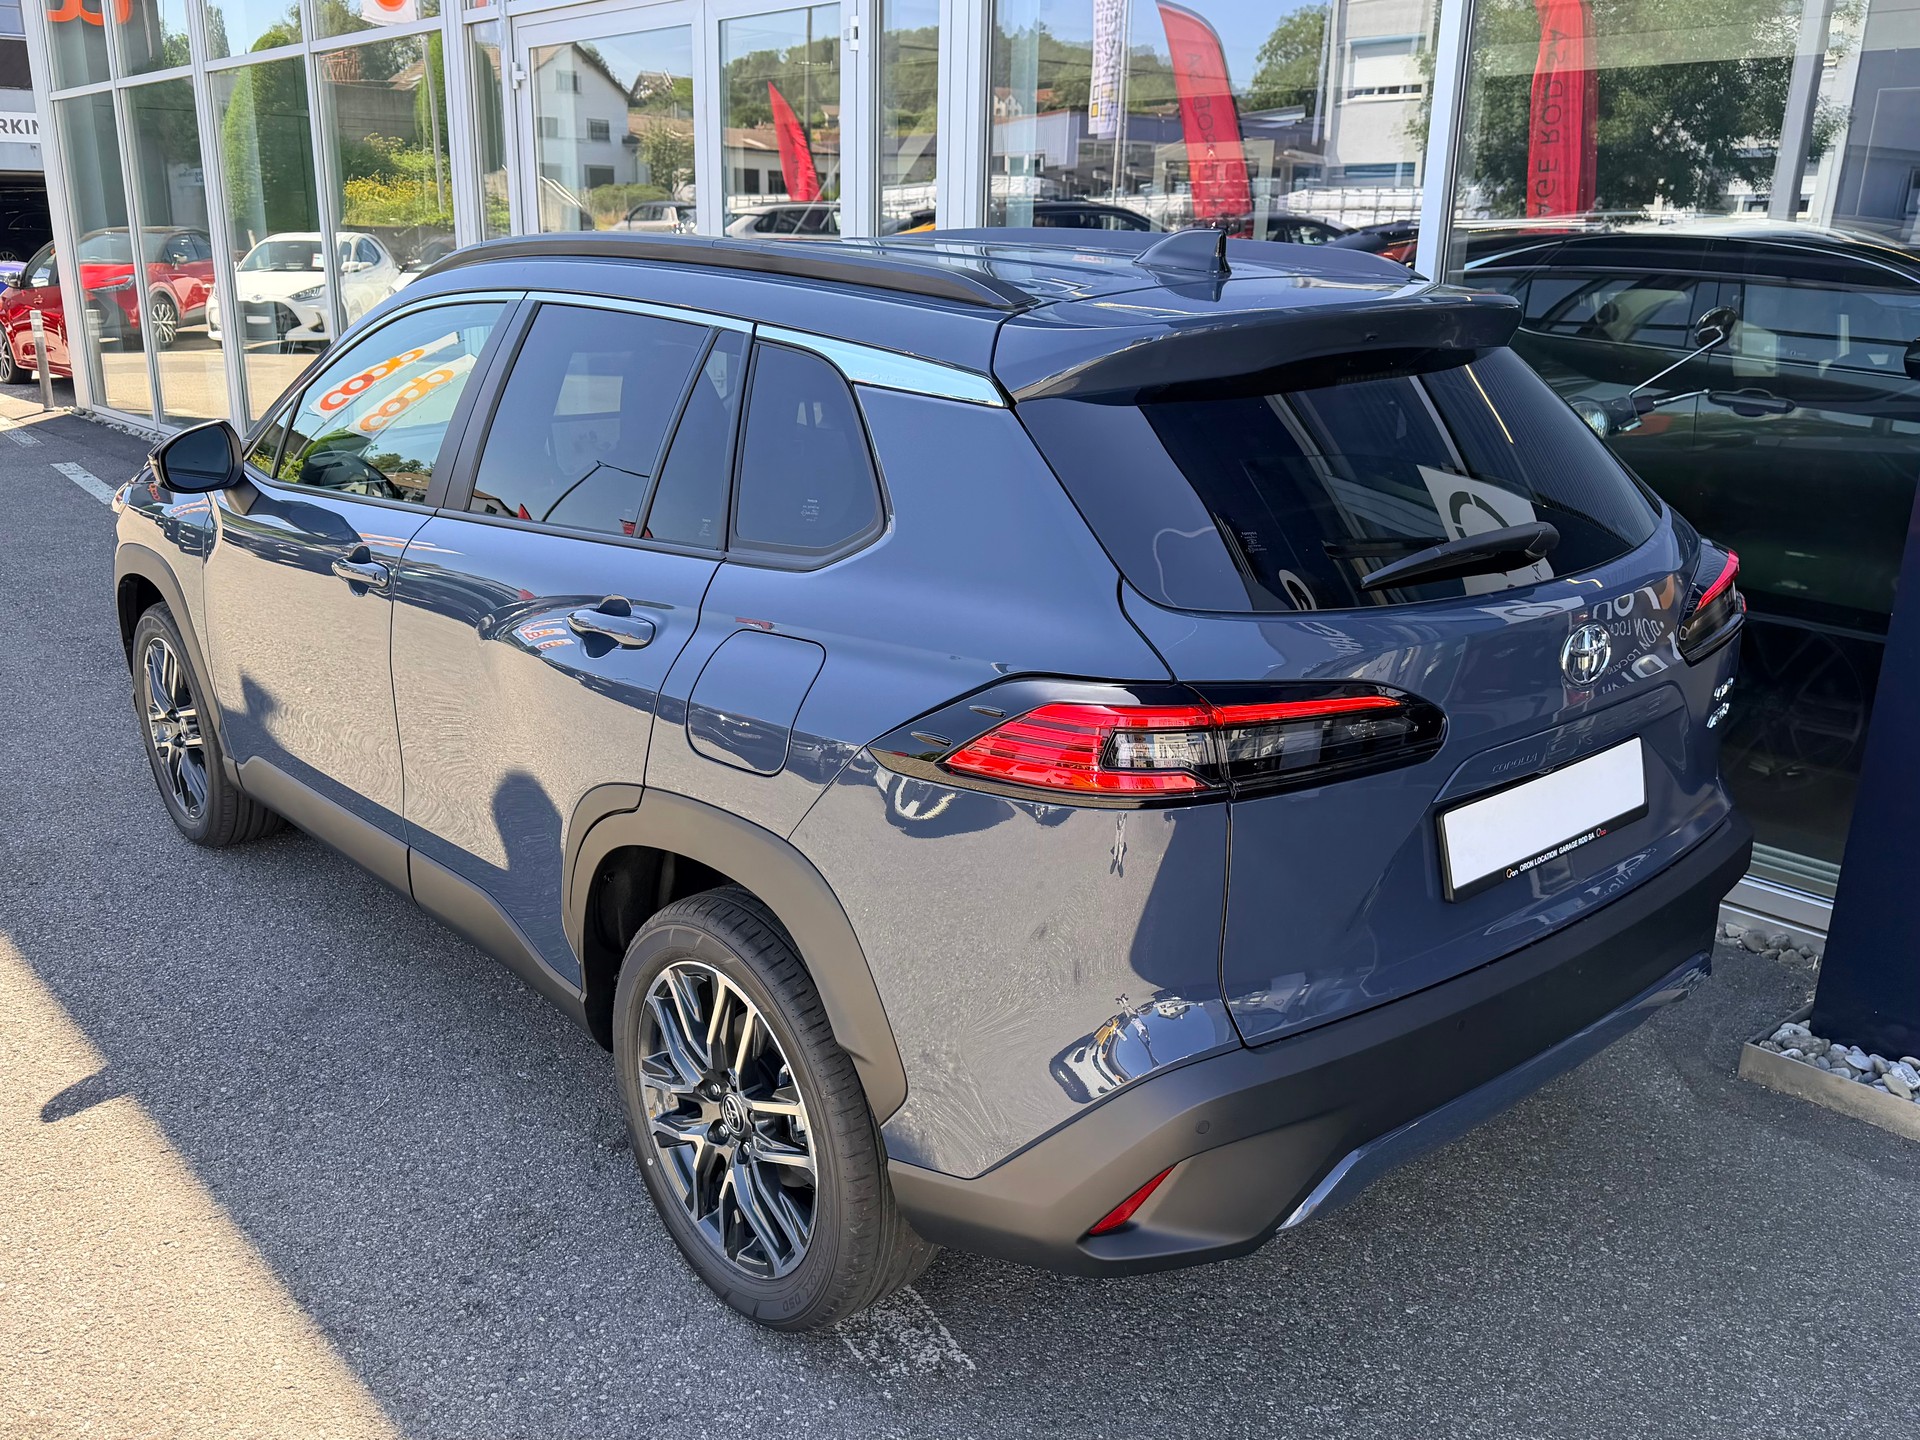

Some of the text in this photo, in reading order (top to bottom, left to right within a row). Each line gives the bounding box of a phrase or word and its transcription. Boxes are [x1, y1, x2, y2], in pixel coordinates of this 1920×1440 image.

[1519, 860, 1534, 871] ORON
[1534, 850, 1557, 865] LOCATION
[1559, 840, 1578, 853] GARAGE
[1578, 836, 1588, 845] ROD
[1588, 832, 1595, 841] SA
